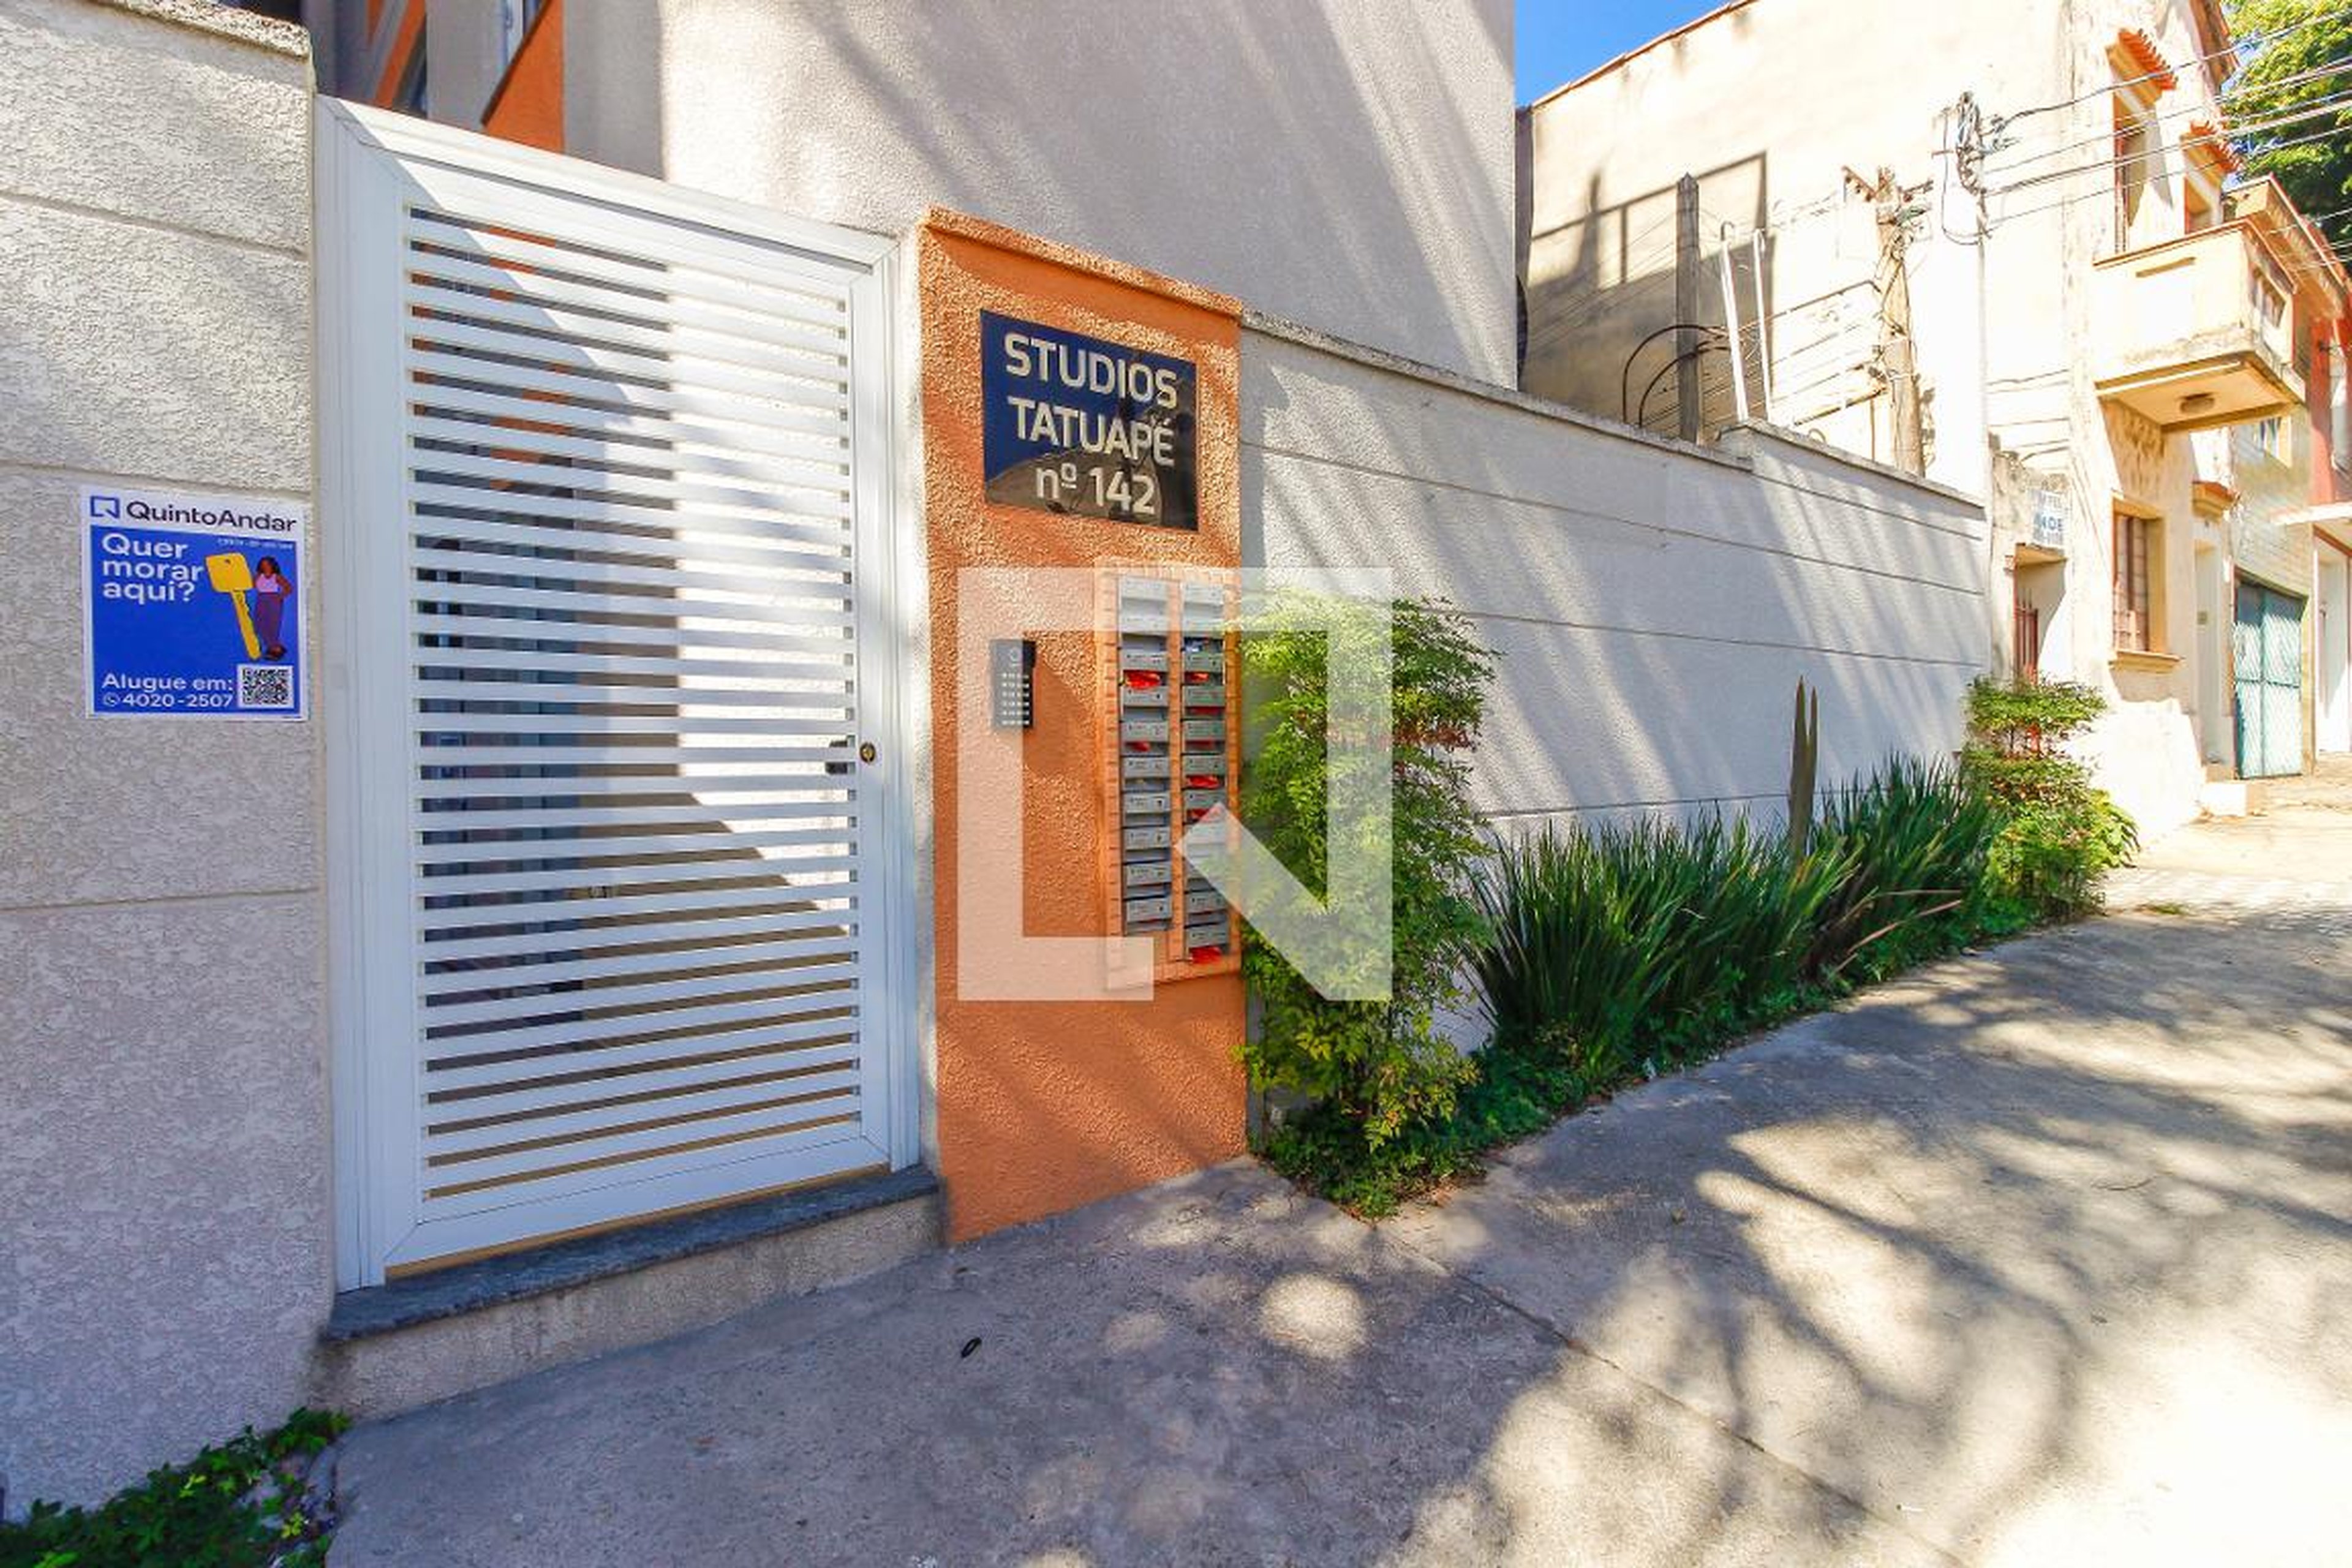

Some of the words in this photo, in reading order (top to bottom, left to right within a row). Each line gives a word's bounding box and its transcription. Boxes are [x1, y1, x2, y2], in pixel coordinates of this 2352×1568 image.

[1004, 333, 1177, 409] STUDIOS
[1008, 395, 1175, 466] TATUAPÉ
[1090, 467, 1155, 514] 142
[126, 501, 297, 532] QuintoAndar
[102, 533, 188, 559] Quer
[102, 559, 205, 582] morar
[102, 580, 195, 604] aqui?
[102, 673, 186, 692] Alugue
[192, 676, 233, 692] em:
